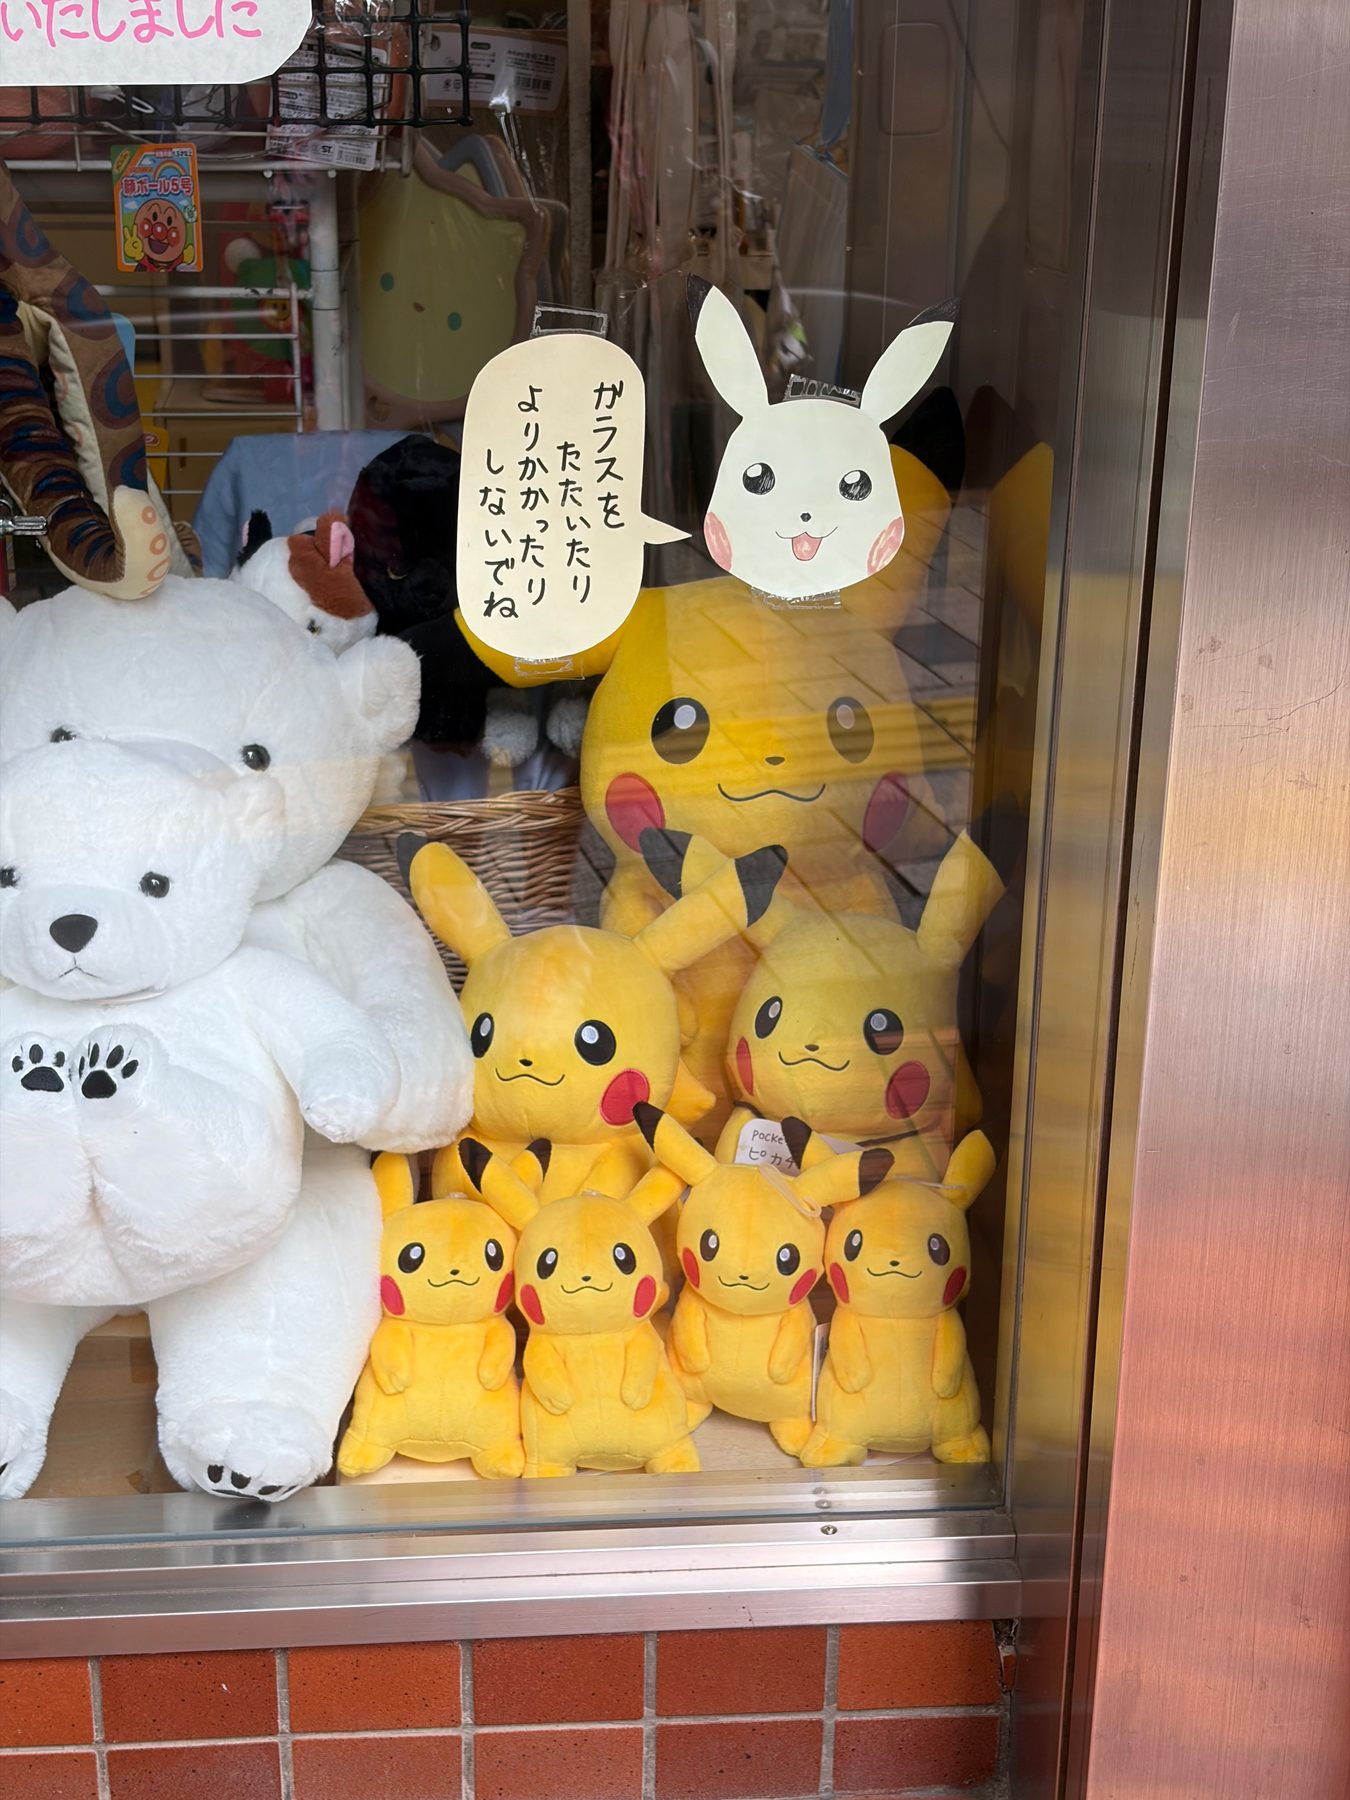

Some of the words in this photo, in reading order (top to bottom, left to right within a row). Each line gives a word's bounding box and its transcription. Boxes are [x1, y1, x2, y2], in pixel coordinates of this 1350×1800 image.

[479, 449, 518, 618] しないでね
[517, 385, 550, 605] よりかかったり
[556, 441, 591, 603] たたいたり
[593, 380, 625, 529] ガラスを
